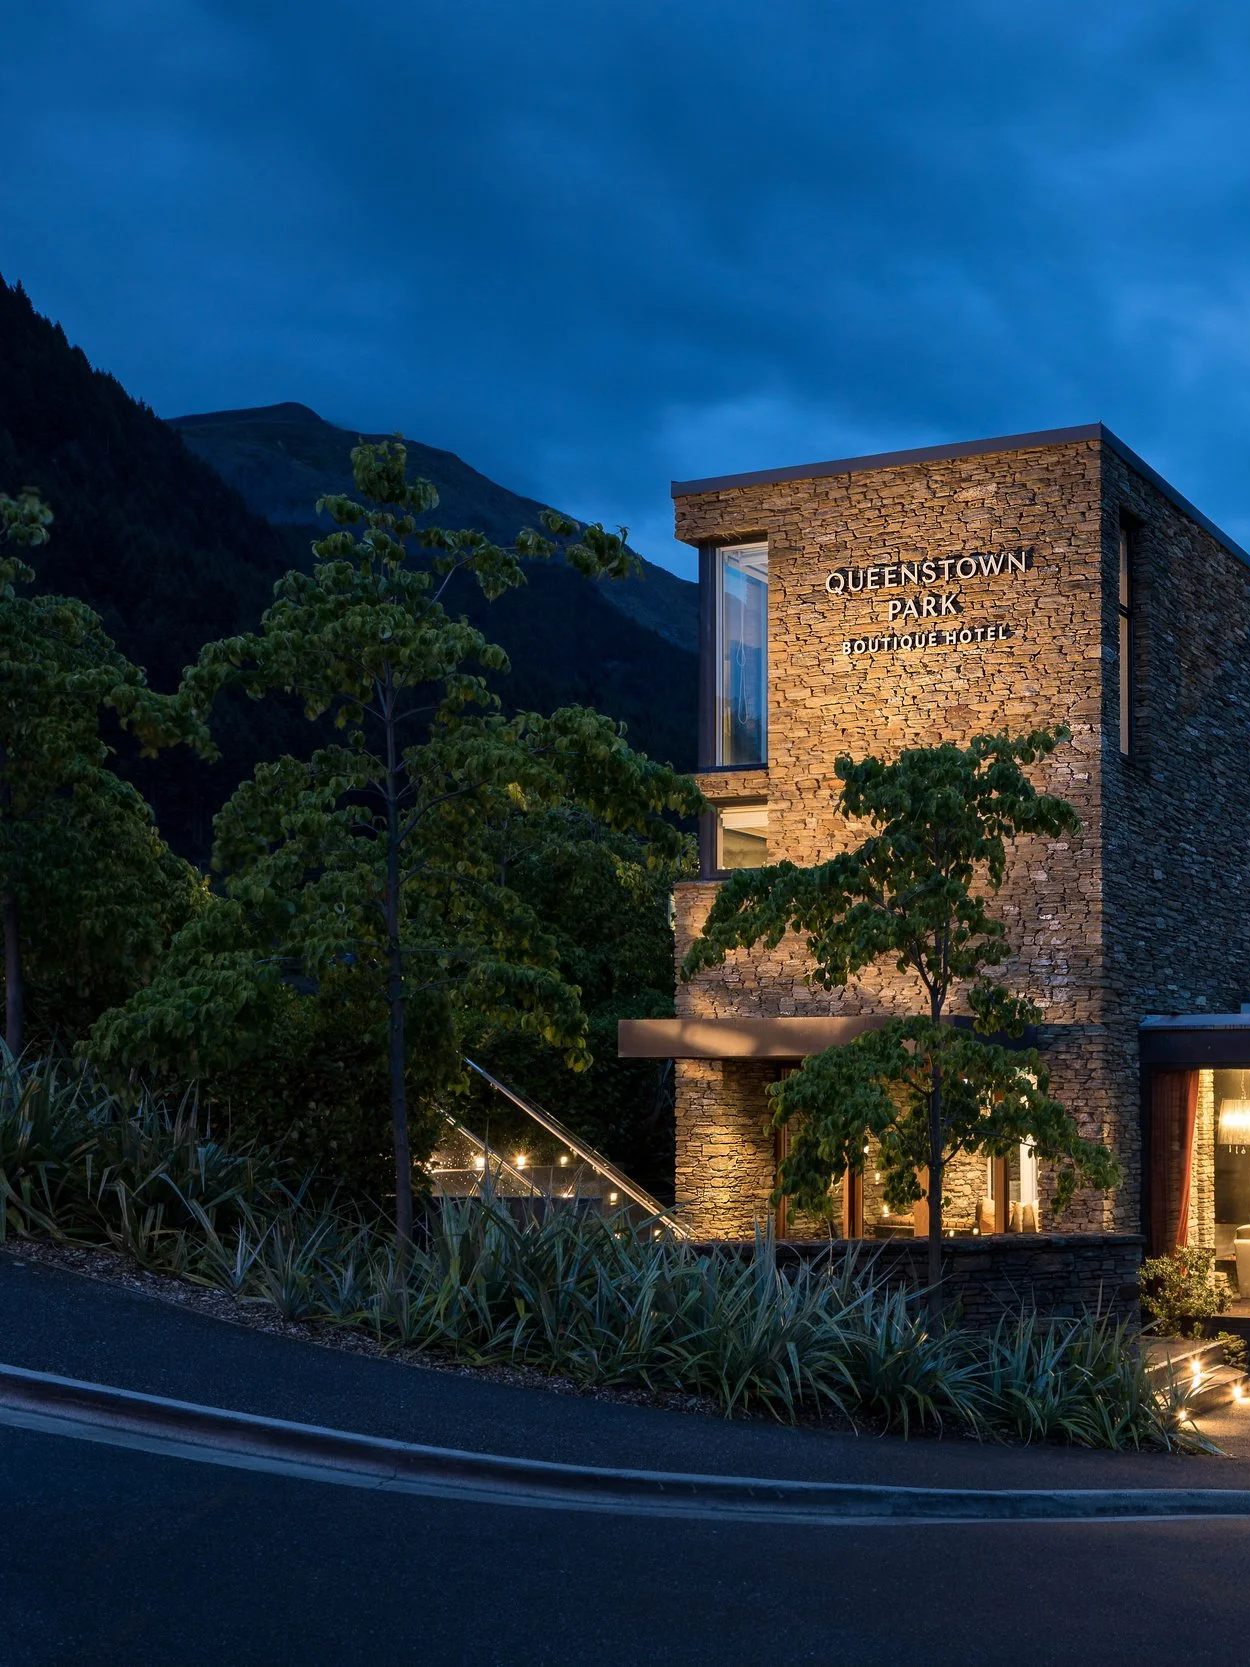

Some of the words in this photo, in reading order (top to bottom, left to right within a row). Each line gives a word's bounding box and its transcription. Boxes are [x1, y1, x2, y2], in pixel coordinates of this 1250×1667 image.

[825, 551, 1027, 596] QUEENSTOWN
[888, 593, 958, 622] PARK
[842, 632, 938, 656] BOUTIQUE
[945, 626, 1008, 647] HOTEL
